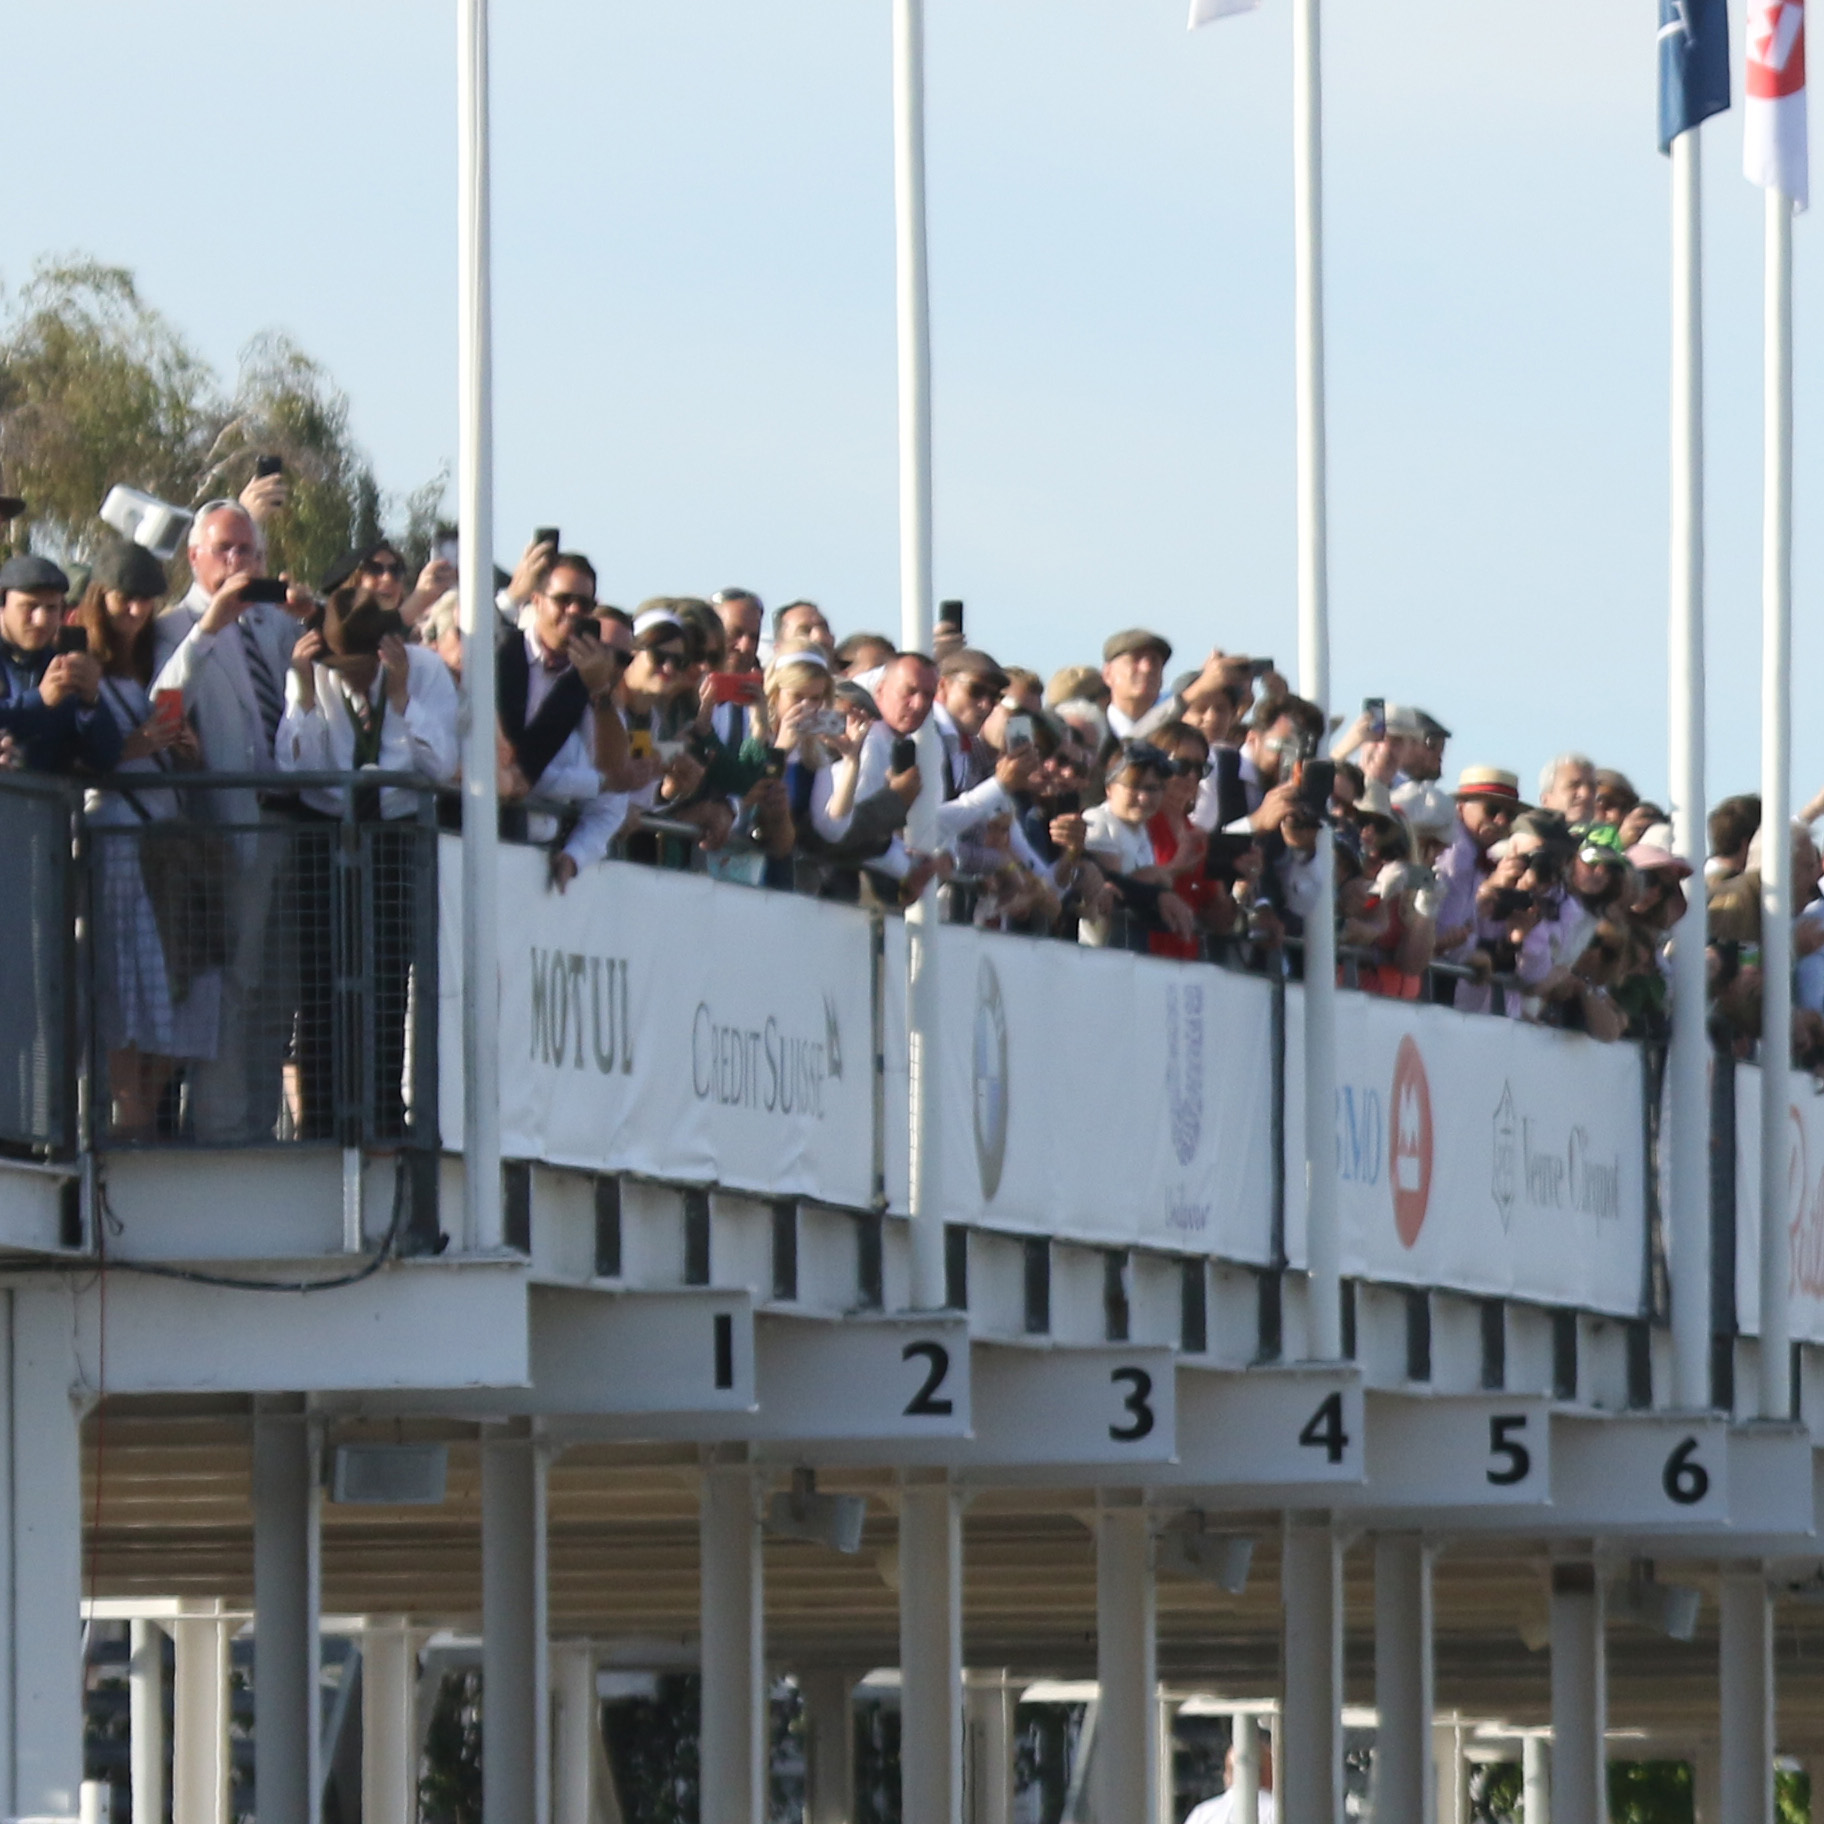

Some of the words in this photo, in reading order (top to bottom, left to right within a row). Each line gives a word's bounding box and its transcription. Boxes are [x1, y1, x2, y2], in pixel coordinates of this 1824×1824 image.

[530, 946, 633, 1076] MOTUL
[714, 1314, 732, 1389] 1
[902, 1340, 952, 1416] 2
[1109, 1366, 1154, 1442] 3
[1299, 1392, 1349, 1464] 4
[1486, 1416, 1530, 1486] 5
[1662, 1437, 1709, 1504] 6
